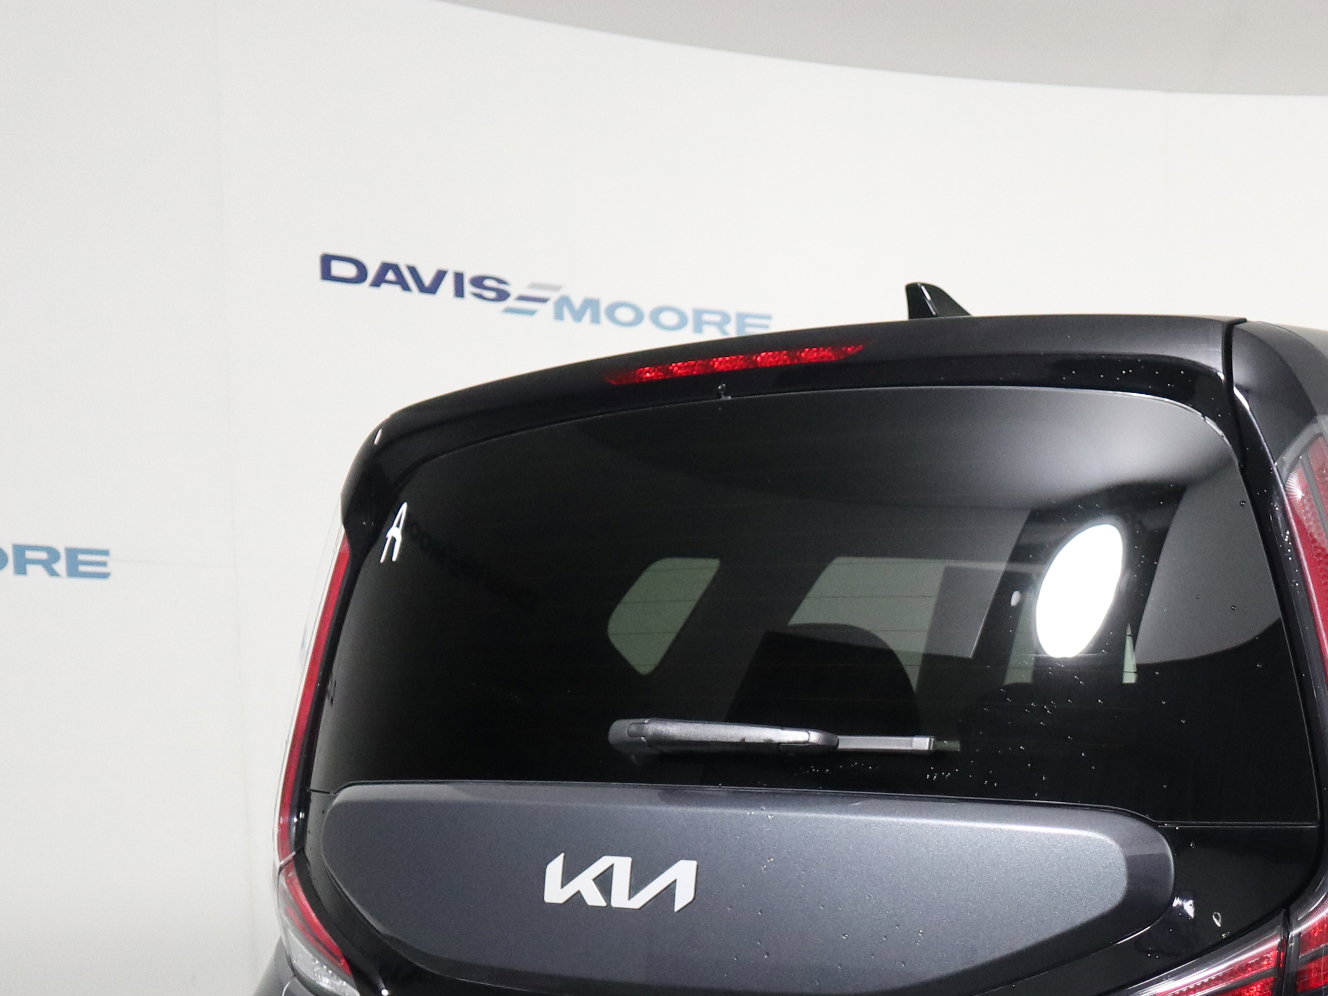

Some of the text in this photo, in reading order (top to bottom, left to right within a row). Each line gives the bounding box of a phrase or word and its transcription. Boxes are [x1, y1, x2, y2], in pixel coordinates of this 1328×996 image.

[319, 252, 773, 337] DAVIS MOORE
[0, 543, 112, 579] RE
[543, 852, 698, 912] KIA
